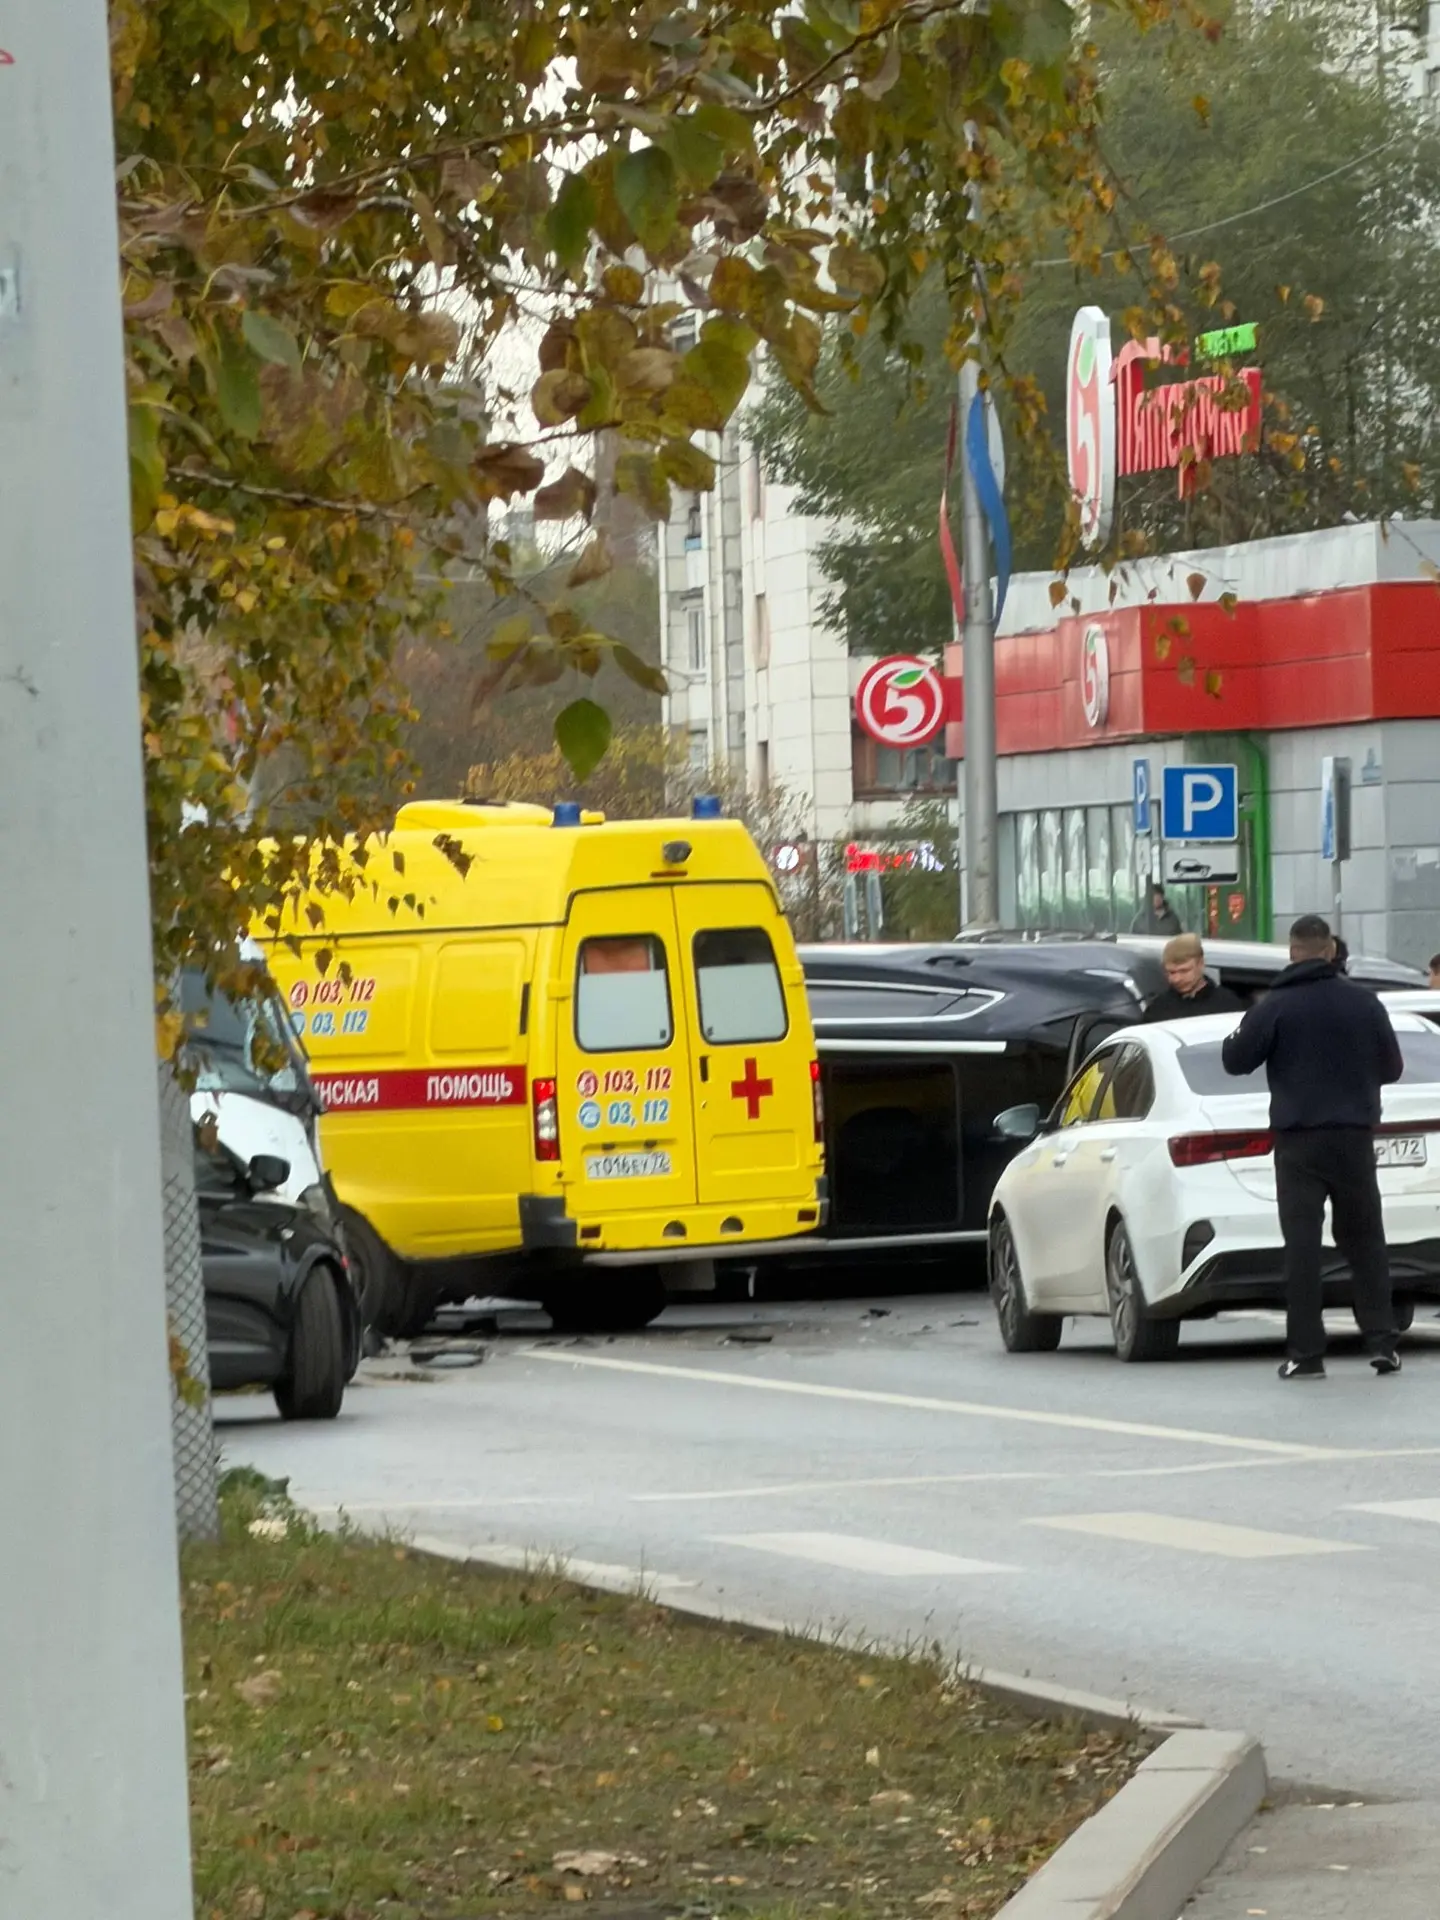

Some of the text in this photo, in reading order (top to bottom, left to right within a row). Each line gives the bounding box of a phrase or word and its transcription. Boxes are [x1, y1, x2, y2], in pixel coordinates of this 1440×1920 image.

[1183, 773, 1223, 832] P
[351, 978, 376, 1003] 112
[342, 1009, 368, 1034] 112
[426, 1072, 514, 1101] ПОМОЩЬ
[646, 1067, 672, 1091] 112
[643, 1099, 669, 1122] 112
[1390, 1139, 1420, 1156] 172
